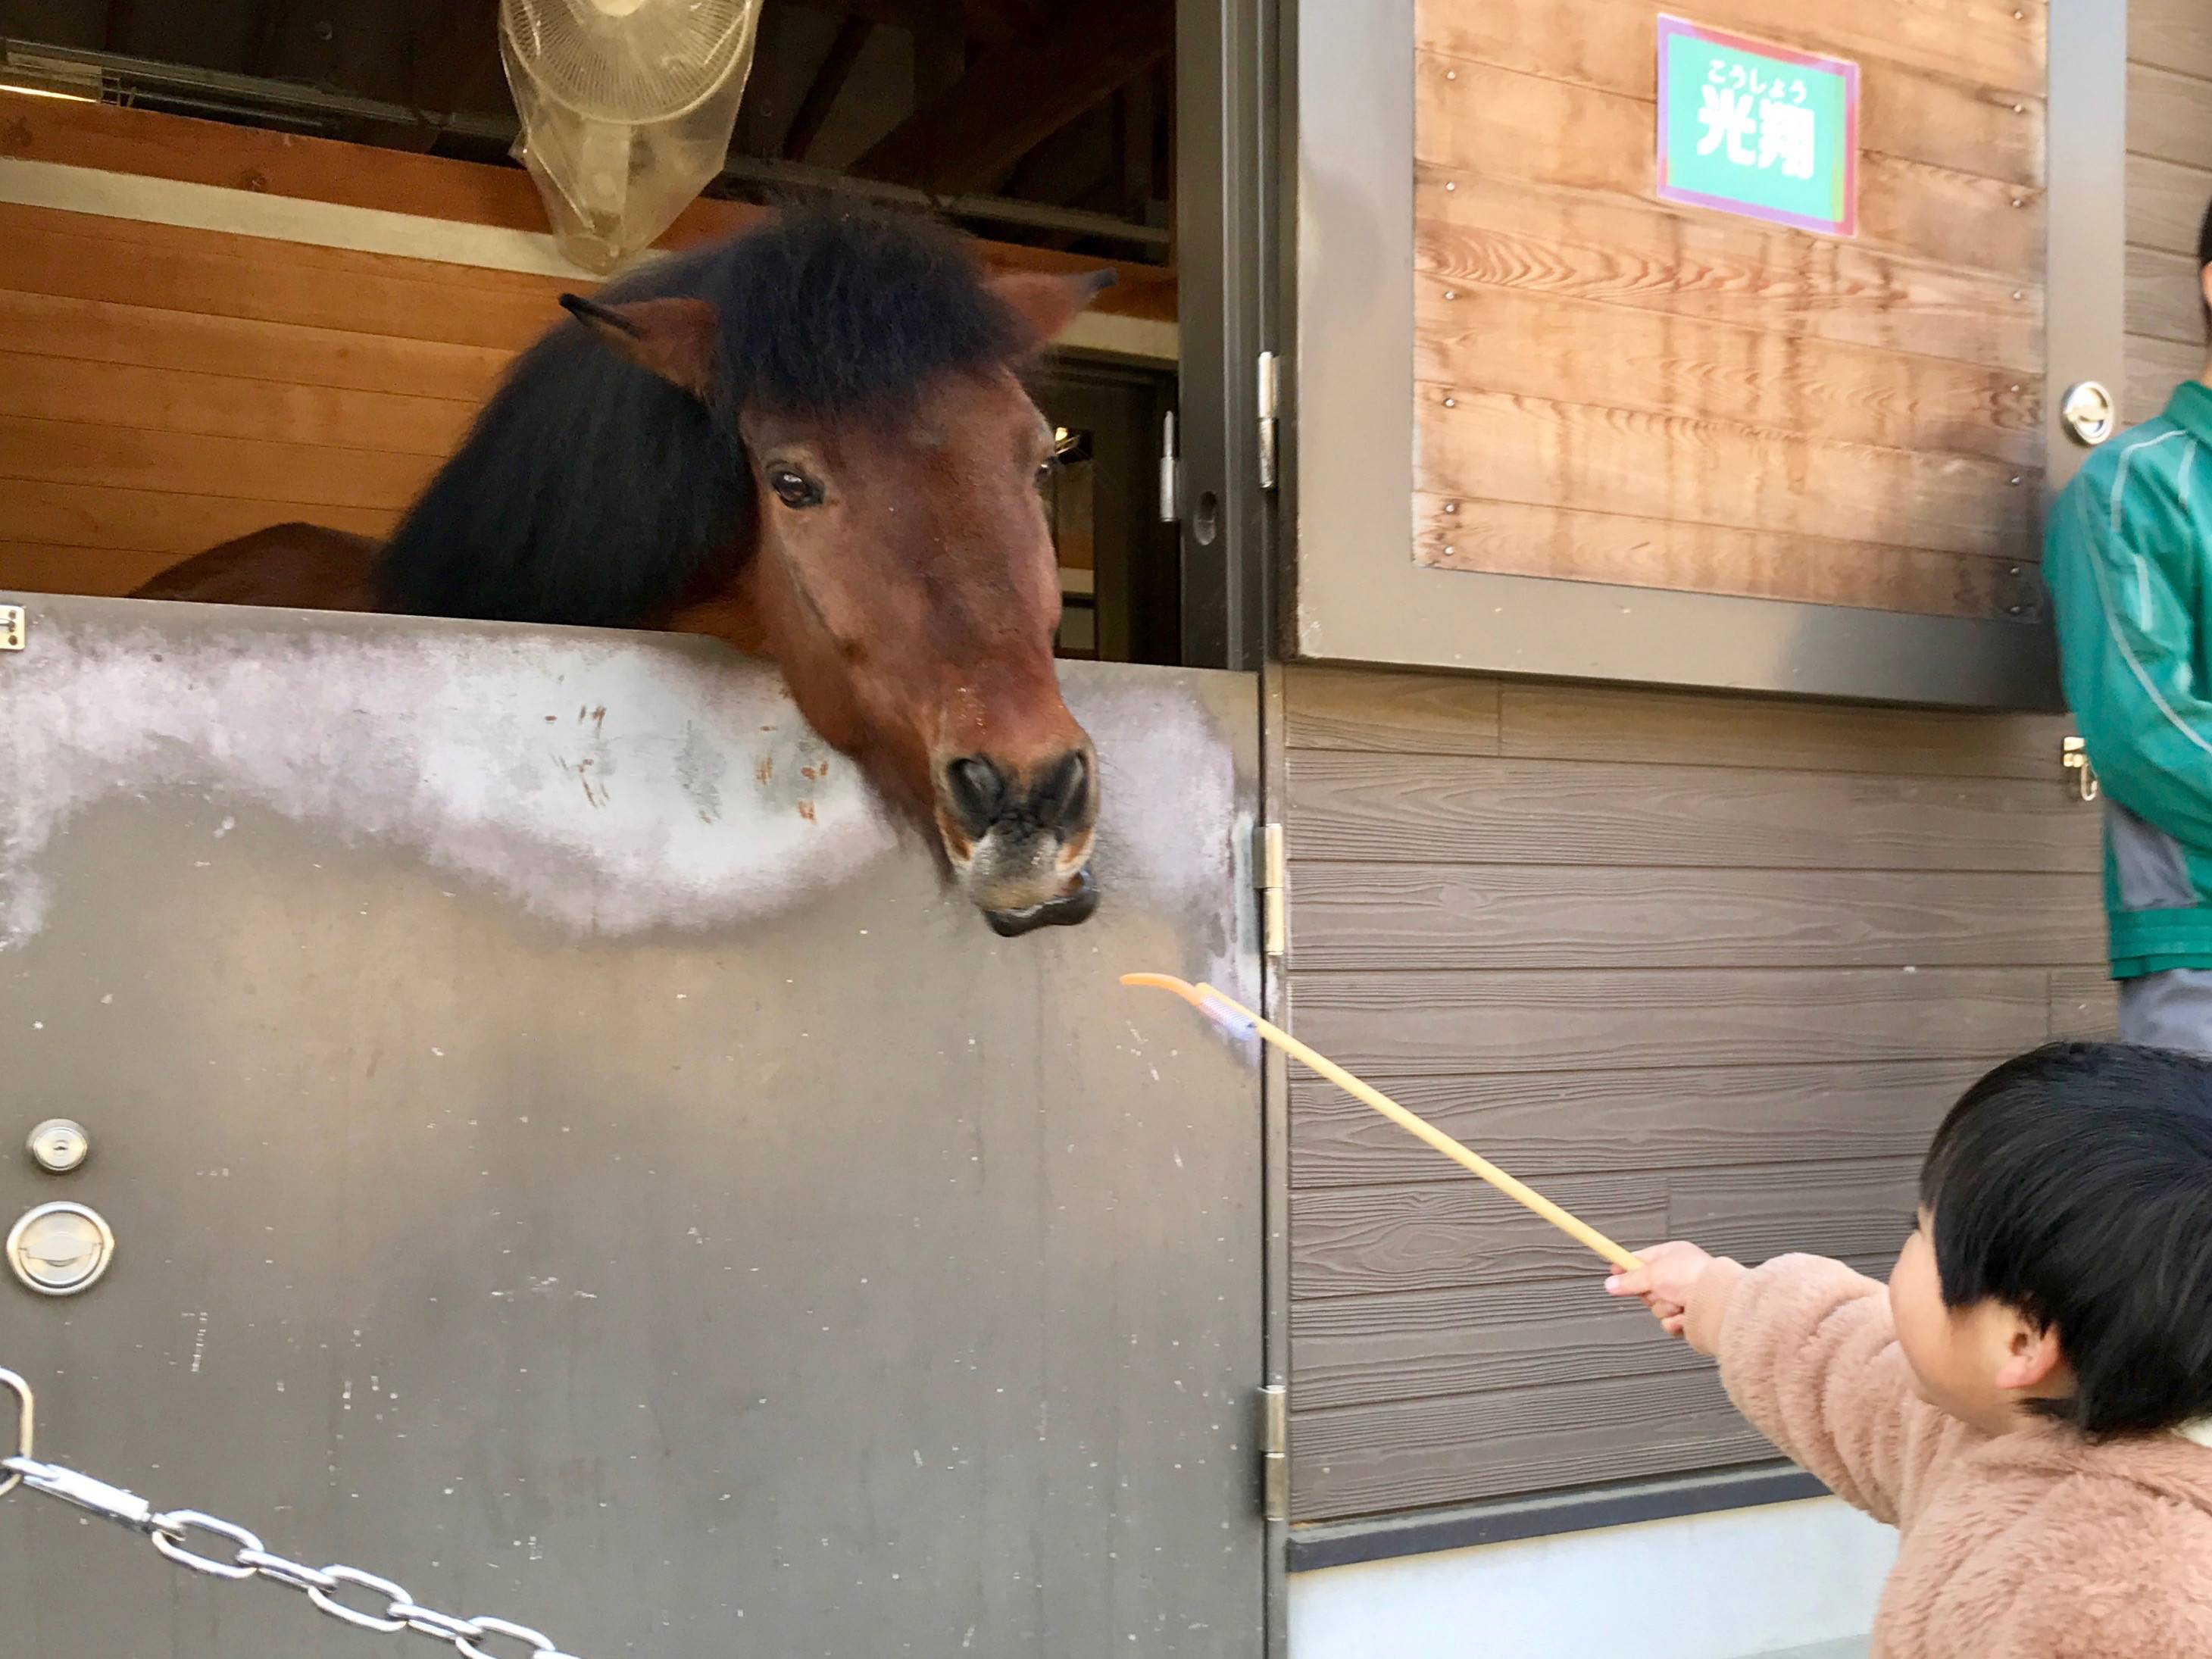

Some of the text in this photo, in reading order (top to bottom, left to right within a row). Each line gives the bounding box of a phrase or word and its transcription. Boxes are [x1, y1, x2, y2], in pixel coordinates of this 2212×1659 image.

[1707, 59, 1807, 104] こうしょう
[1697, 84, 1814, 180] 光翔
